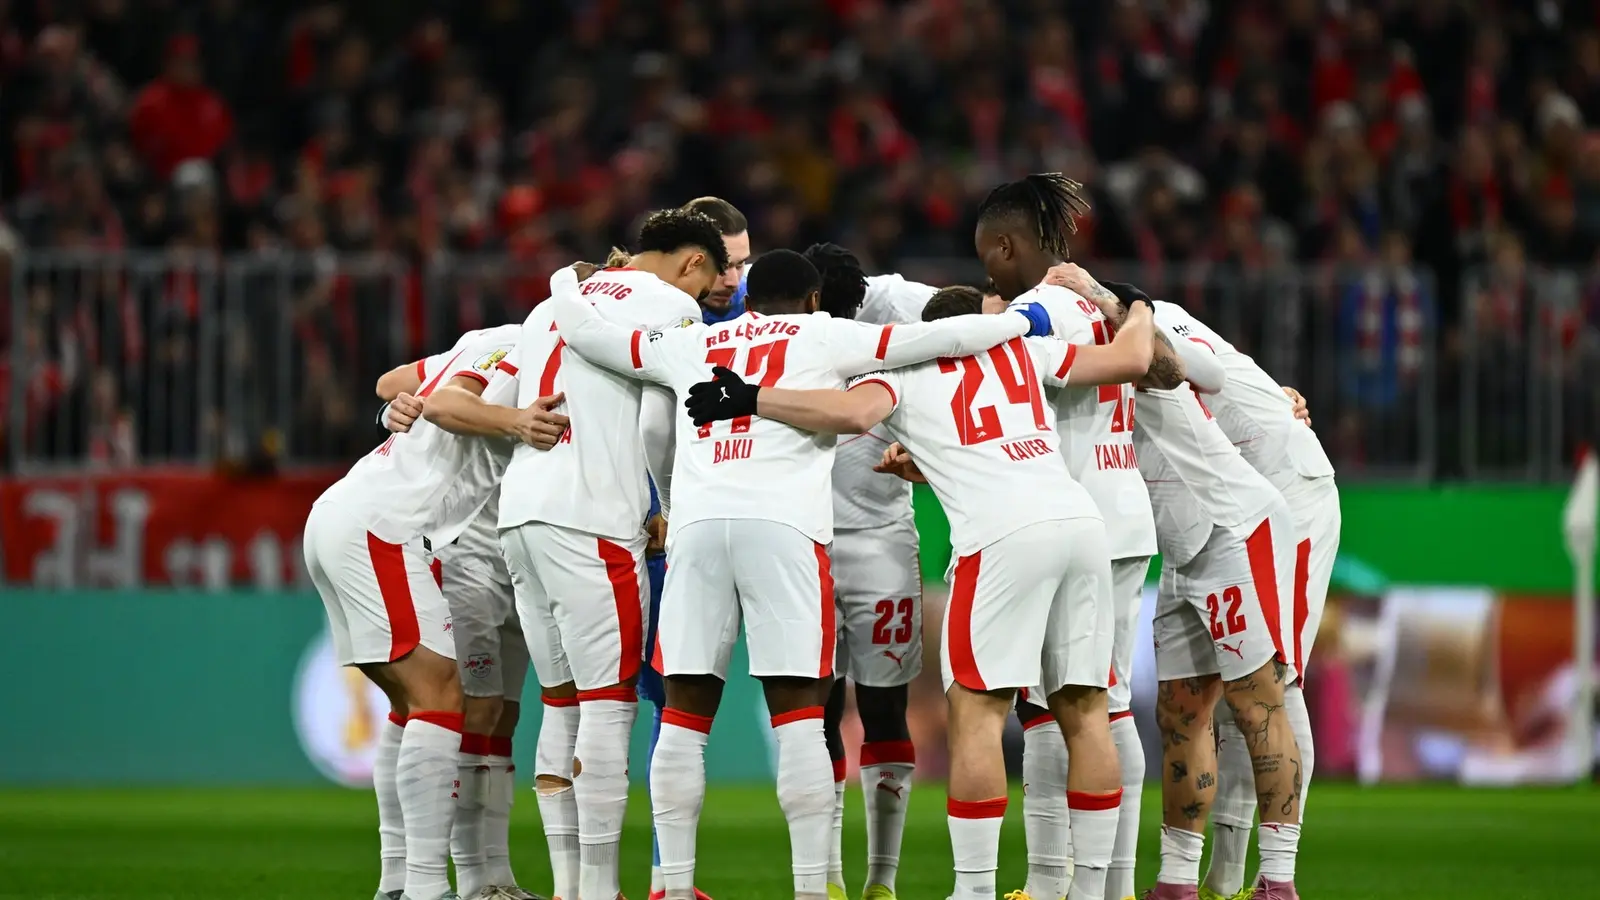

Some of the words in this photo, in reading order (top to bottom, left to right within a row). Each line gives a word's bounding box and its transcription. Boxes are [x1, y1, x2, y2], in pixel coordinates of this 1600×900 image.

[706, 329, 730, 348] RB
[735, 321, 801, 341] LEIPZIG
[936, 335, 1052, 446] 24
[713, 439, 753, 464] BAKU
[1000, 438, 1054, 461] XAVER
[872, 598, 914, 645] 23
[1206, 585, 1247, 640] 22
